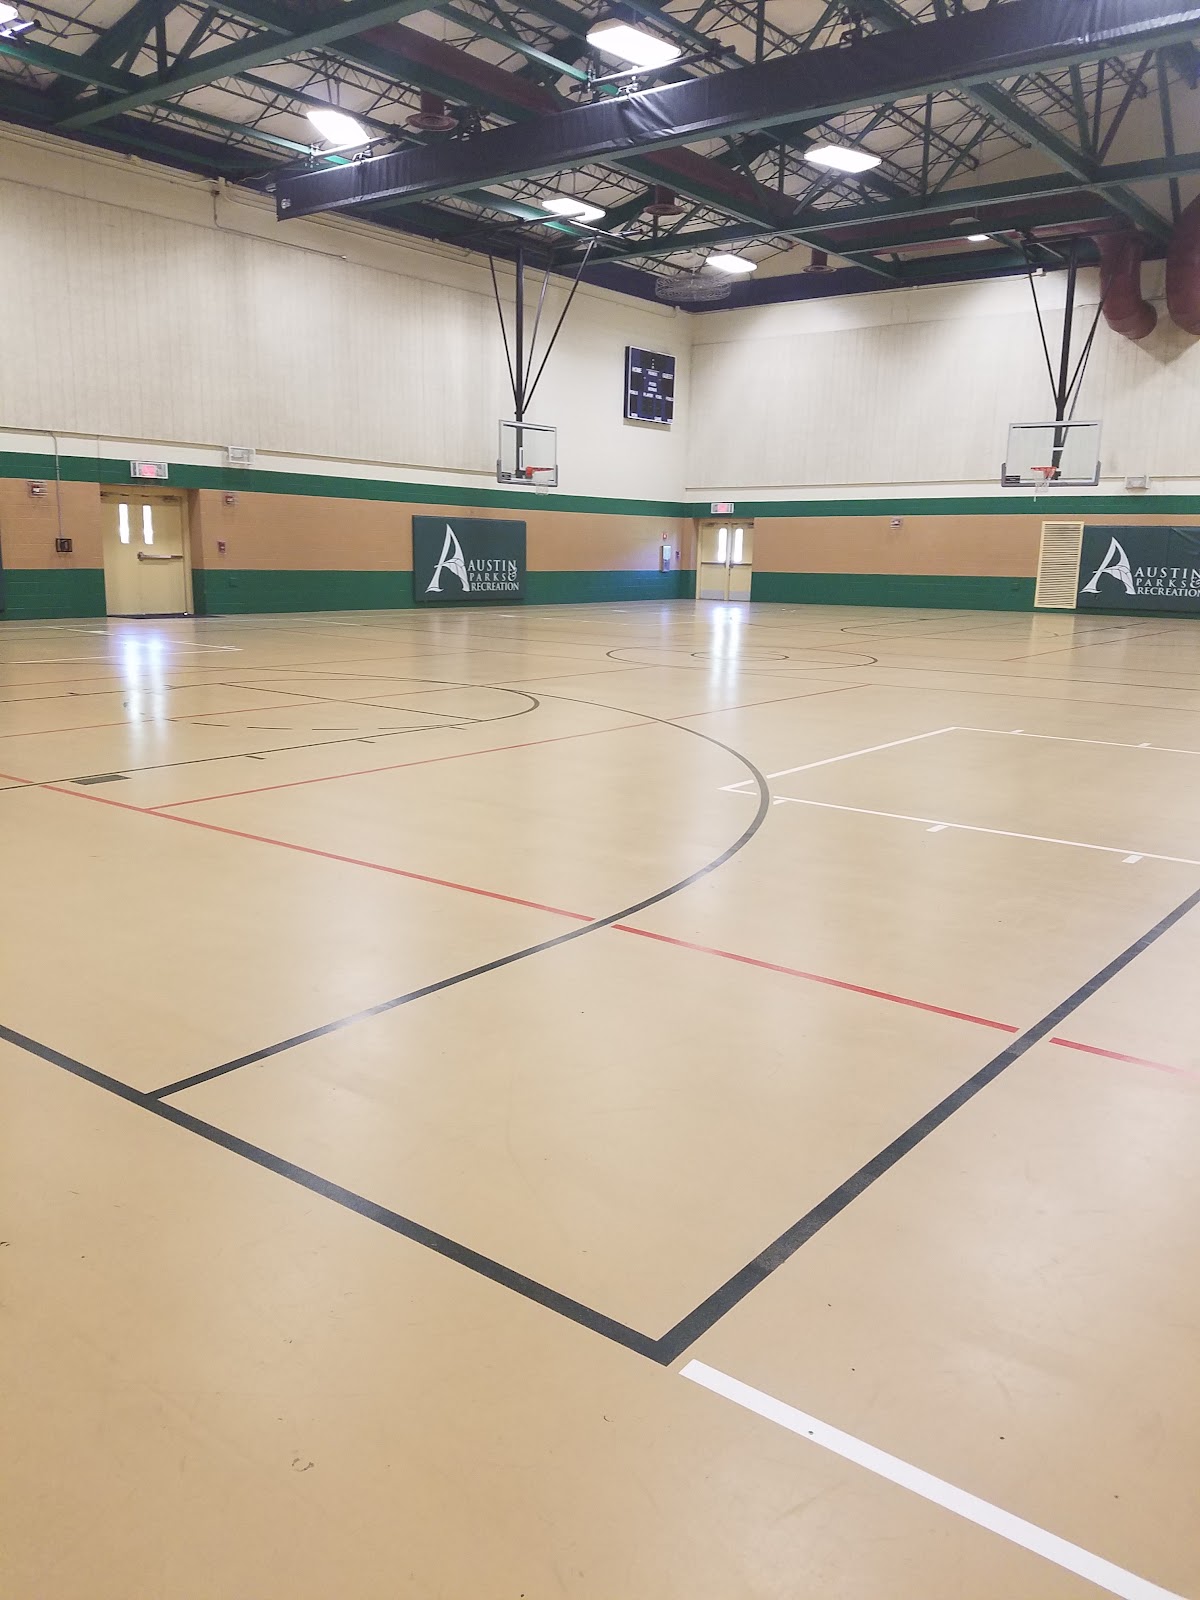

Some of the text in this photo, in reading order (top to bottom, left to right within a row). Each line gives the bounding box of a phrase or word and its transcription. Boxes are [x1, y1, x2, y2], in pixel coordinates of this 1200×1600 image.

[467, 559, 517, 572] AUSTIN
[1134, 566, 1200, 579] AUSTIN
[471, 582, 520, 591] RECREATION
